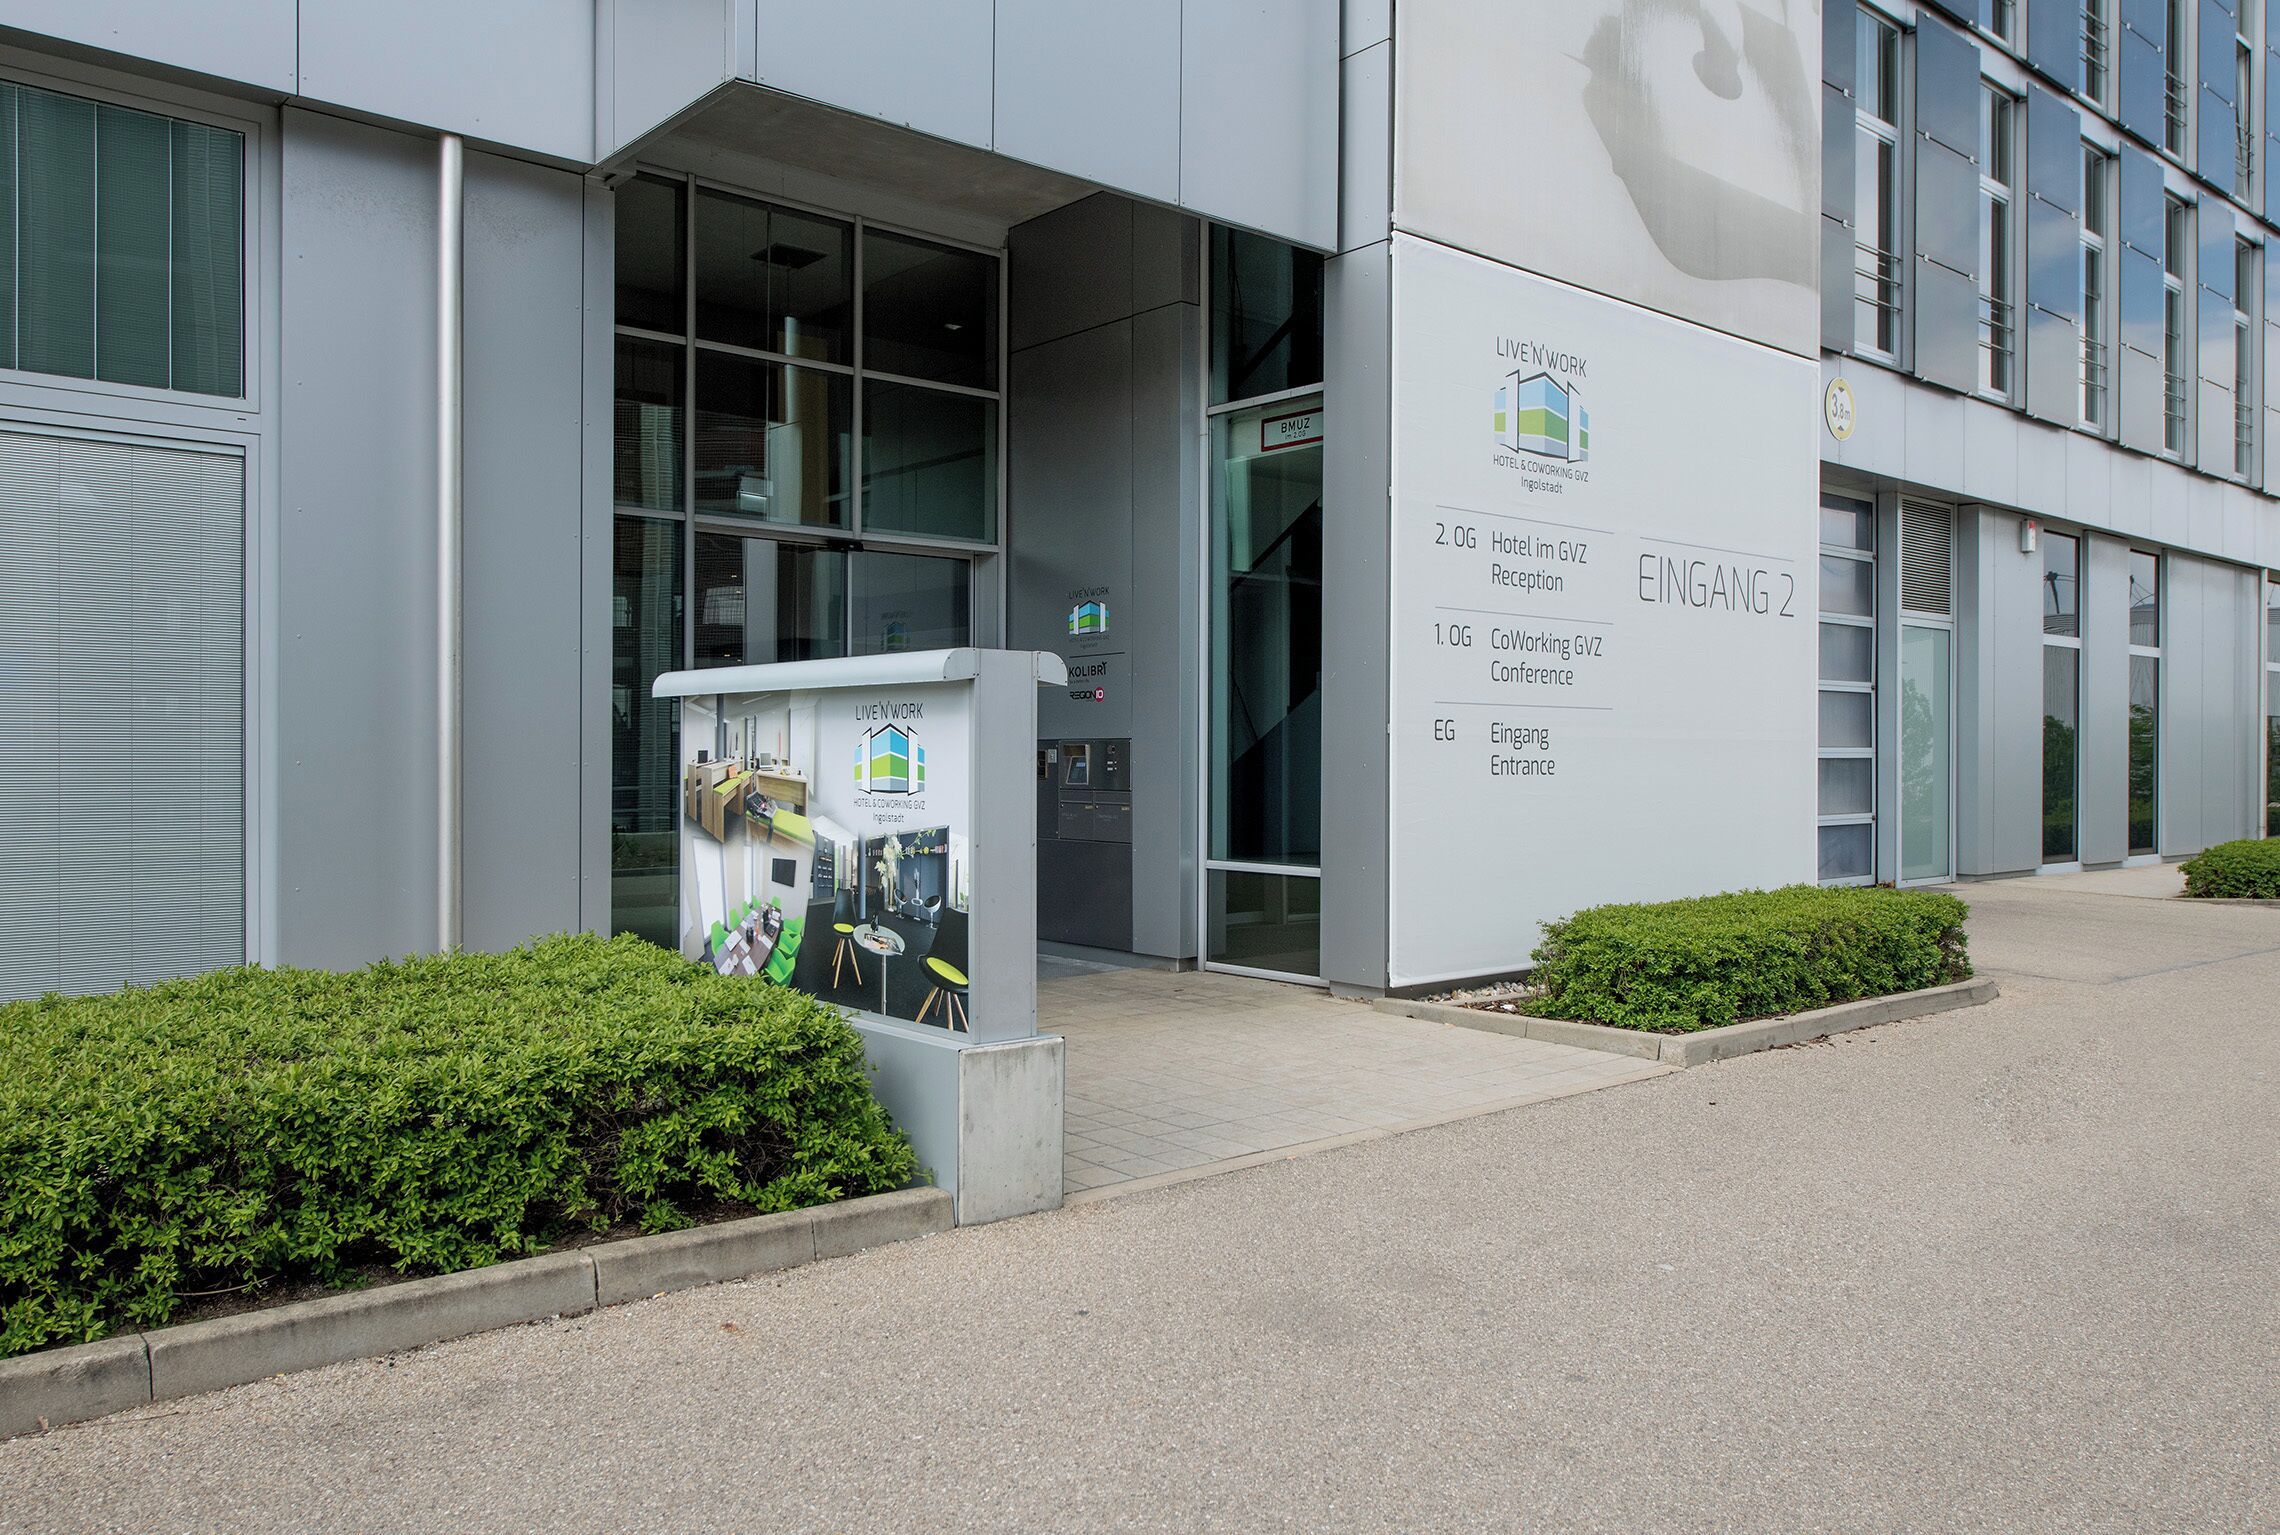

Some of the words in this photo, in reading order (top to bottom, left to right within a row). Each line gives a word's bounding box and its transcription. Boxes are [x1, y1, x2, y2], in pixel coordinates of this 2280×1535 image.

[1281, 417, 1310, 434] BMUZ
[1493, 454, 1519, 470] HOTEL
[1520, 460, 1527, 471] &
[1527, 461, 1573, 480] COWORKING
[1574, 470, 1589, 483] GVZ
[1521, 476, 1563, 495] Ingolstadt
[1454, 525, 1477, 549] OG
[1492, 531, 1532, 557] Hotel
[1536, 537, 1554, 560] im
[1558, 541, 1587, 564] GVZ
[1491, 563, 1563, 594] Reception
[1639, 553, 1769, 615] EINGANG
[1779, 573, 1795, 618] 2
[1450, 624, 1472, 648] OG
[1491, 628, 1570, 661] CoWorking
[1574, 635, 1602, 657] GVZ
[1491, 660, 1574, 686] Conference
[1434, 719, 1455, 741] EG
[1491, 722, 1550, 750] Eingang
[1491, 754, 1555, 776] Entrance
[853, 798, 872, 808] HOTEL
[877, 798, 913, 810] COWORKING
[914, 800, 926, 810] GVZ
[872, 812, 905, 825] Ingolstadt
